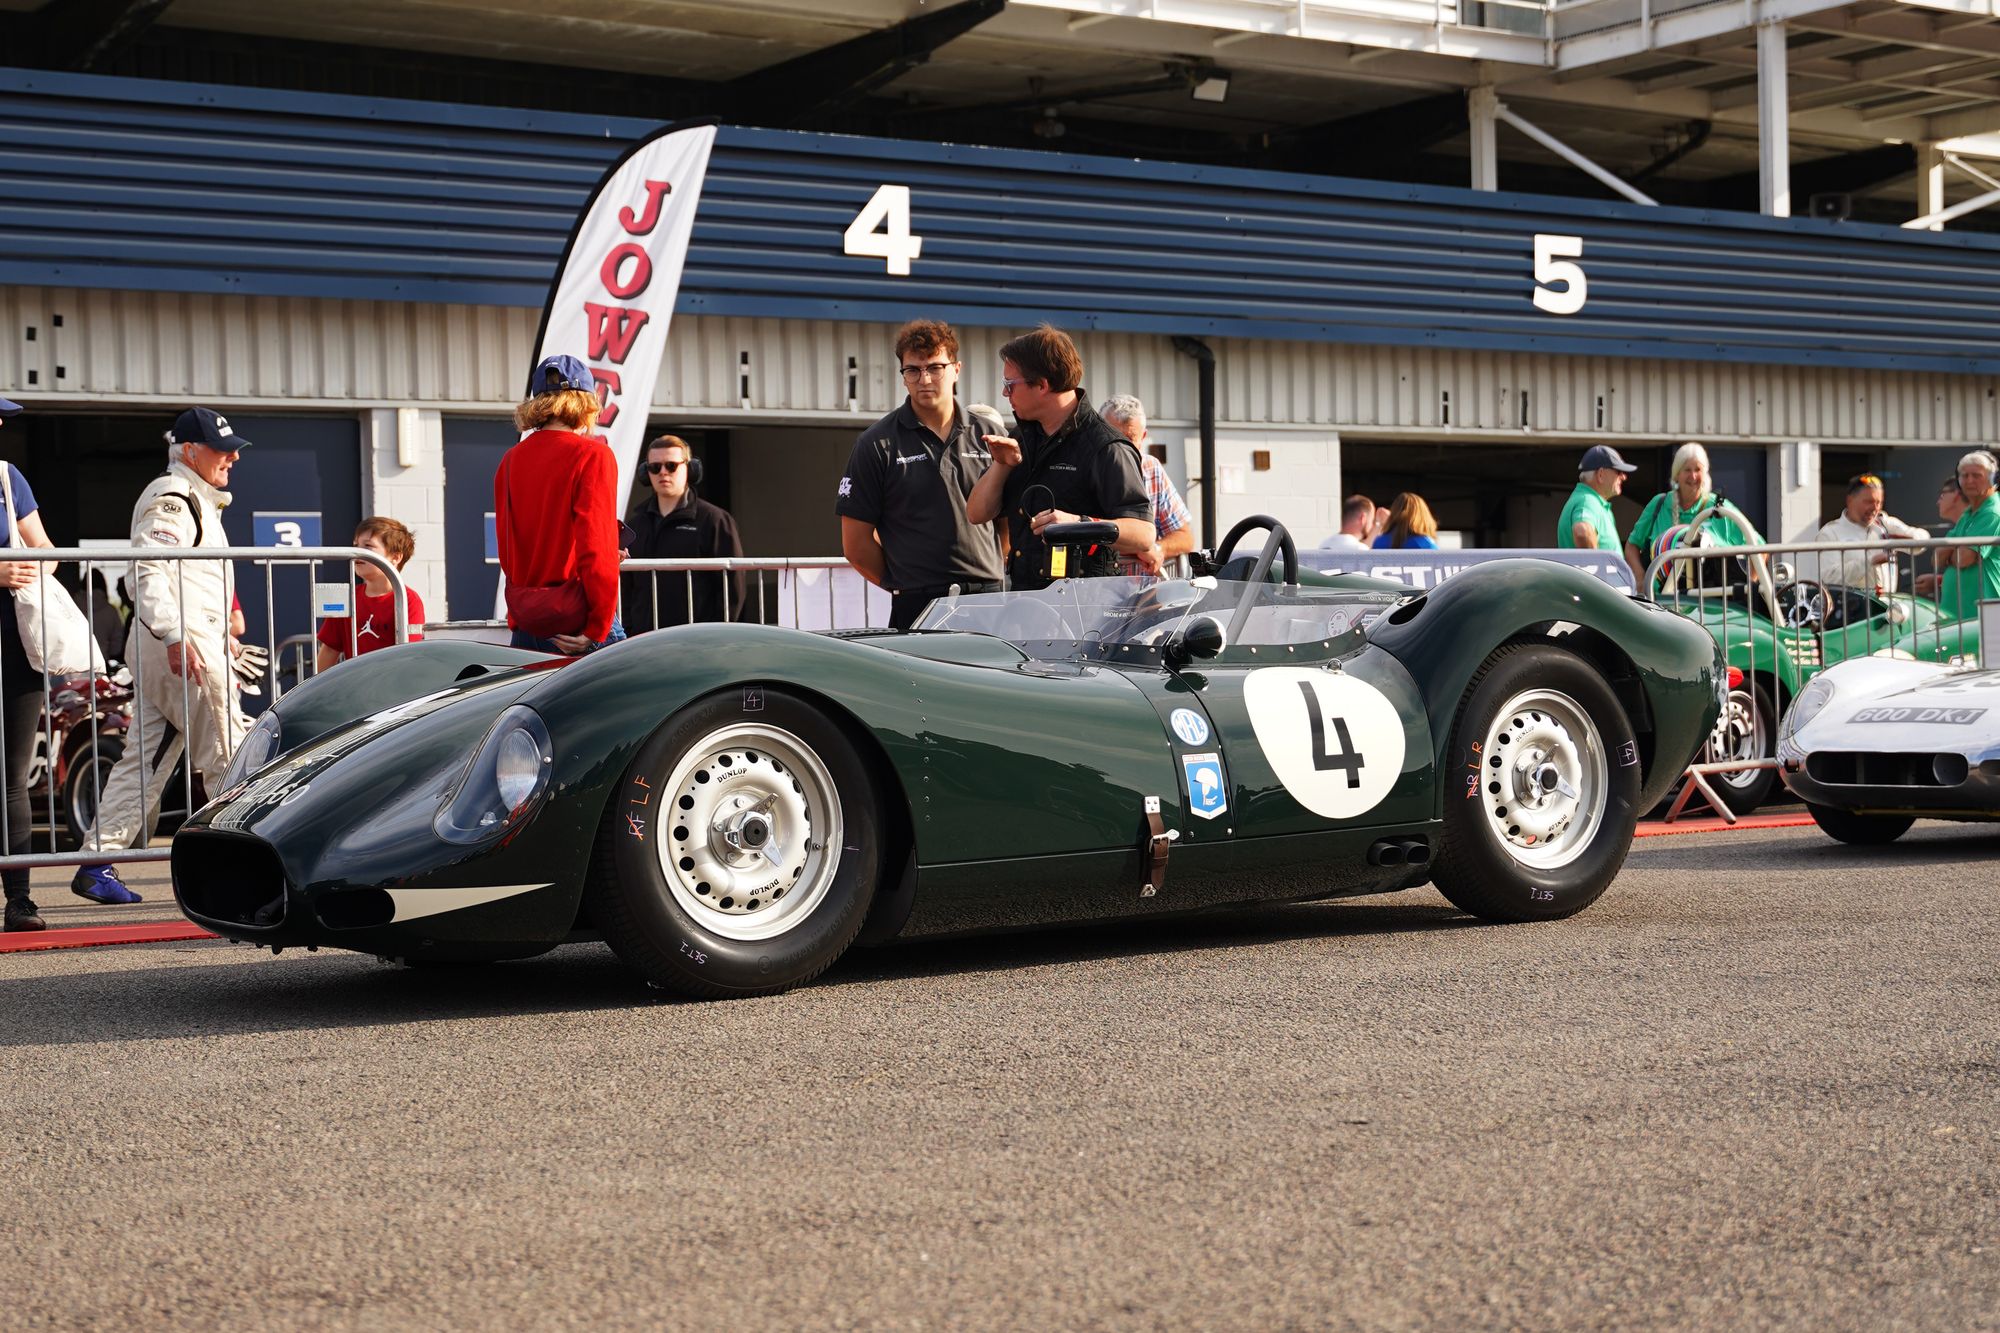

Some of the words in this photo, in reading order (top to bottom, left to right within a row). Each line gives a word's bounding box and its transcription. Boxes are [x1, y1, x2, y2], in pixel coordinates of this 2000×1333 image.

[844, 184, 922, 275] 4
[1533, 233, 1587, 314] 5
[273, 521, 303, 548] 3
[1854, 708, 1910, 722] 600
[1914, 708, 1985, 723] DKJ
[1297, 681, 1365, 788] 4
[1515, 725, 1535, 743] DUNLOP
[717, 767, 748, 783] DUNLOP
[1548, 813, 1568, 832] DUNLOP
[749, 879, 780, 896] DUNLOP
